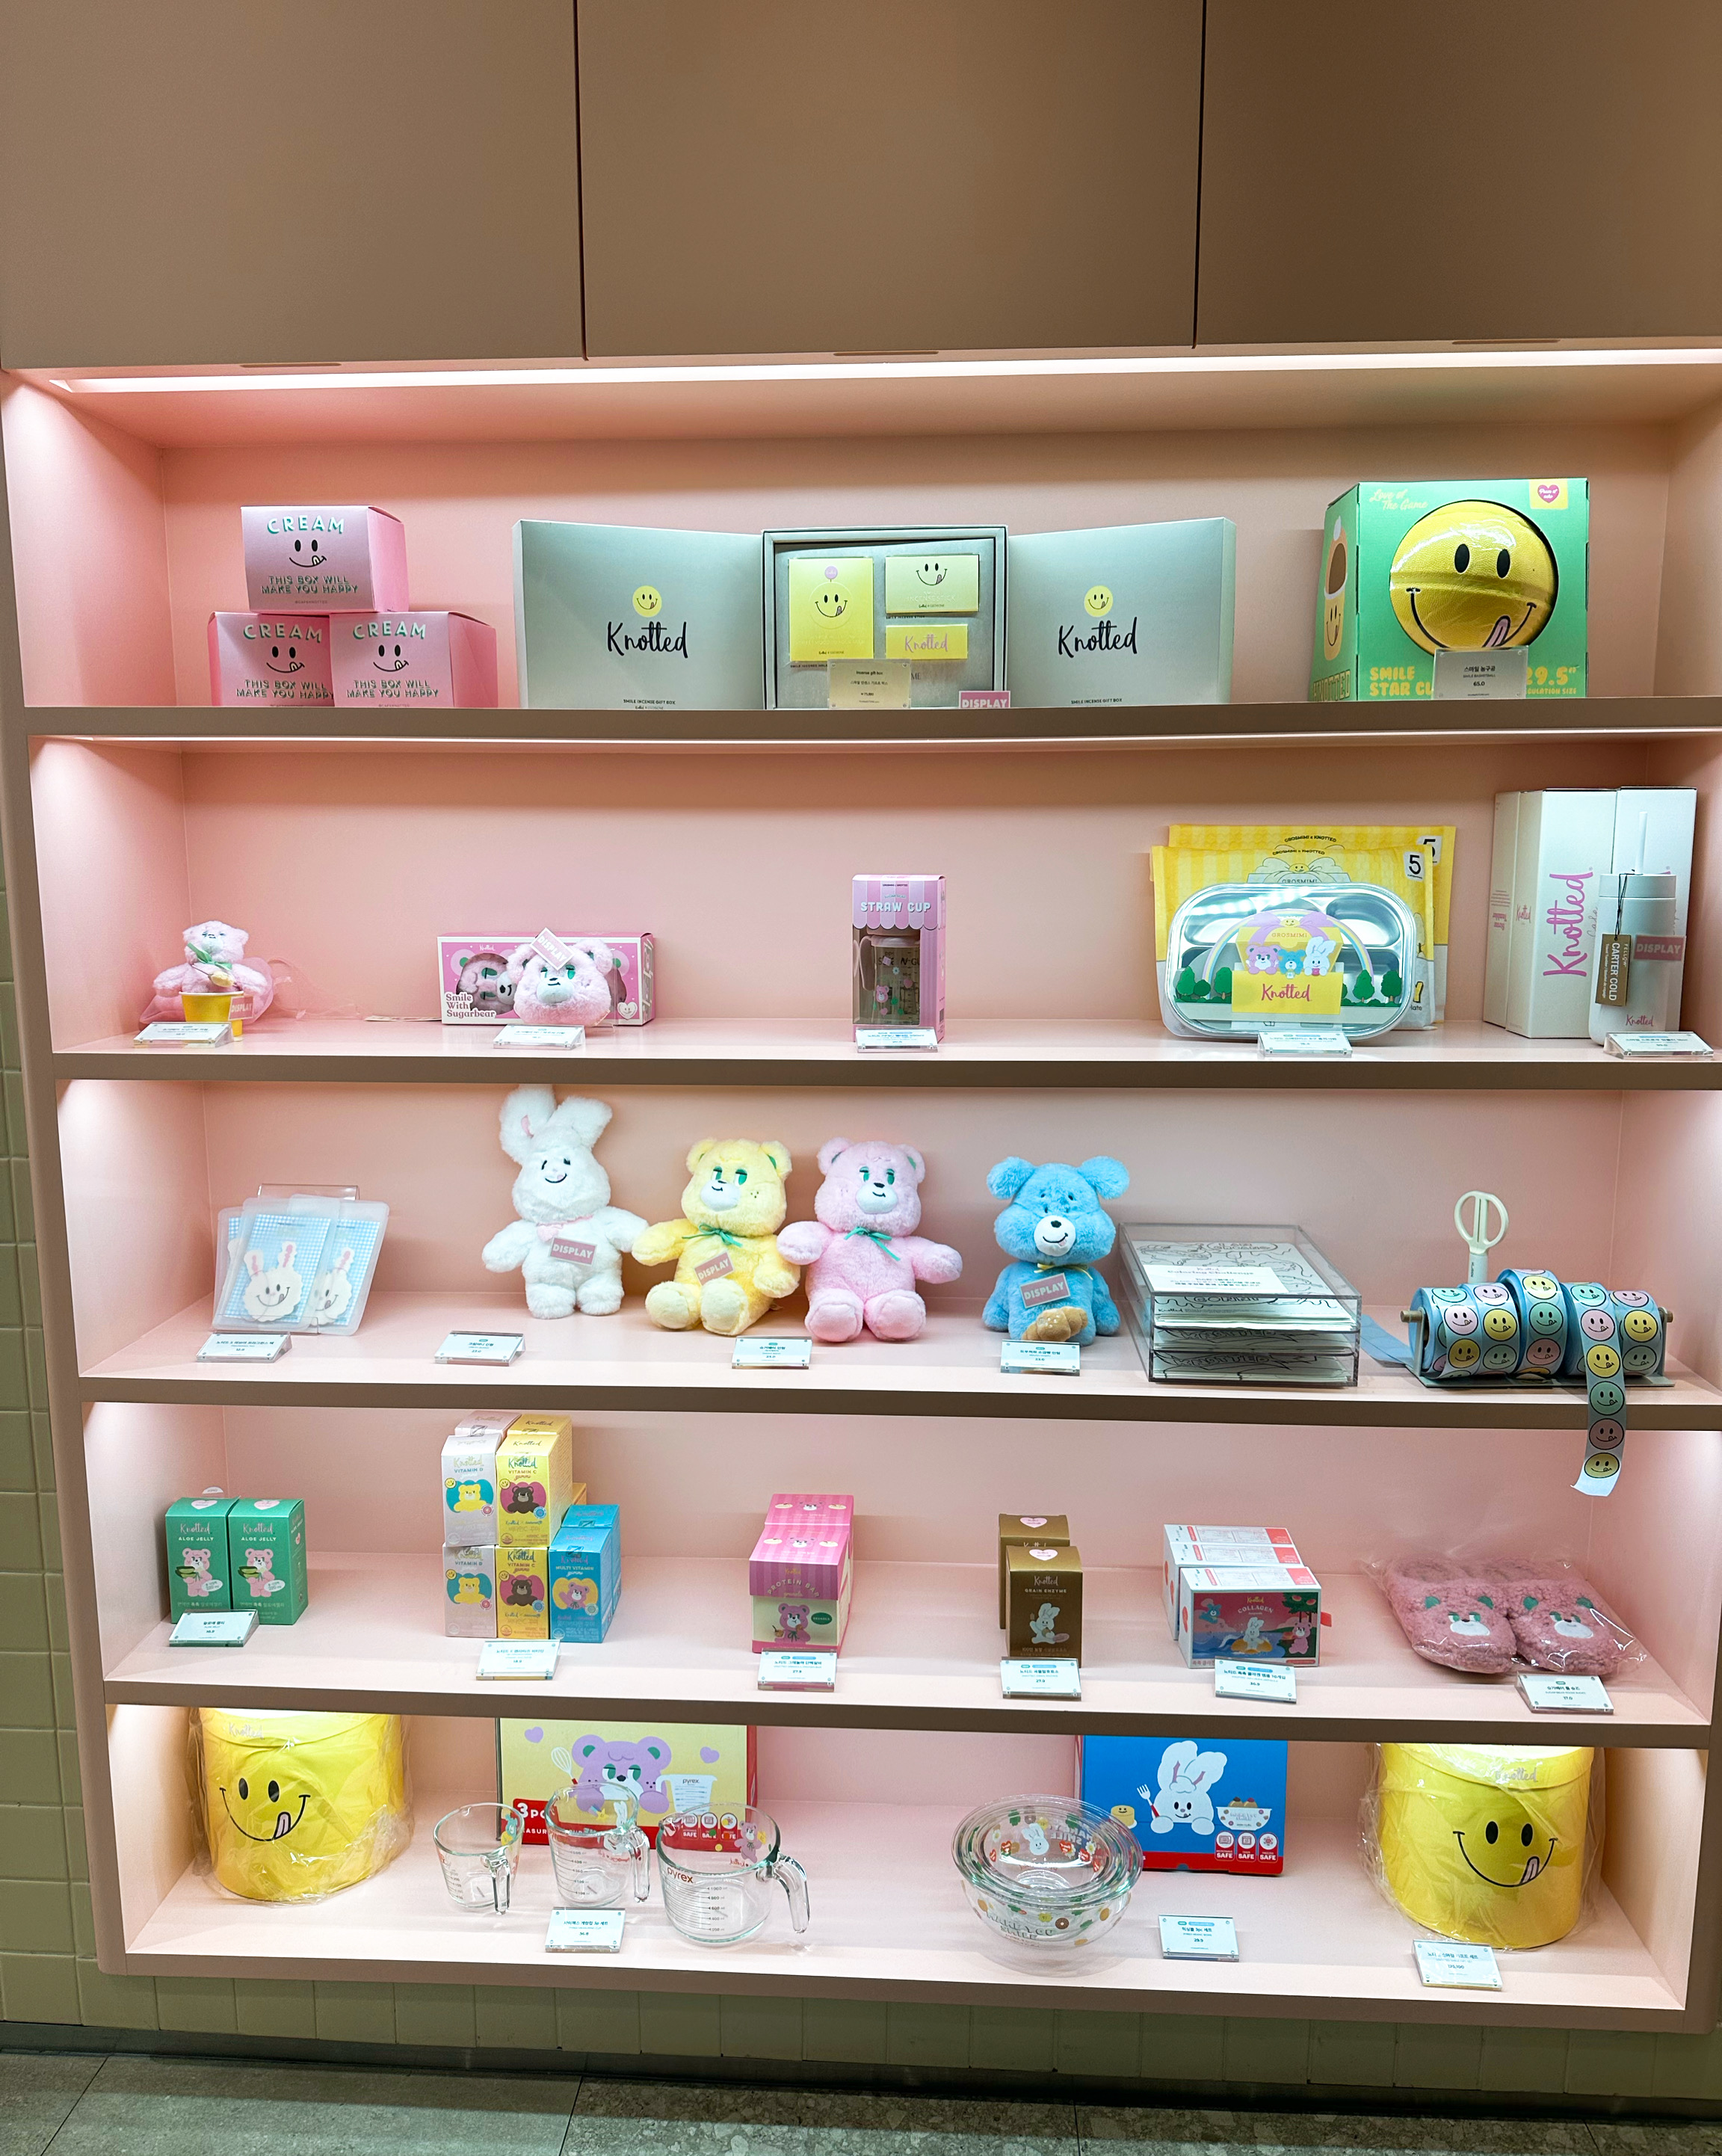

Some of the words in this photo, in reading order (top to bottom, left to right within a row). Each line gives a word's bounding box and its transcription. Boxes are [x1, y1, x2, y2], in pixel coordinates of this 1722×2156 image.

[1382, 500, 1398, 510] The
[1400, 501, 1428, 510] Game
[267, 515, 345, 535] CREAM
[269, 576, 293, 584] THIS
[297, 576, 318, 585] BOX
[262, 585, 291, 594] MAKE
[297, 585, 317, 594] YOU
[322, 585, 358, 594] HAPPY
[244, 623, 322, 643] CREAM
[353, 621, 426, 640] CREAM
[607, 621, 688, 659] Knotted
[904, 634, 948, 653] Knotted
[1058, 617, 1138, 658] Knotted
[1370, 666, 1415, 680] SMILE
[245, 680, 269, 689] THIS
[274, 680, 296, 689] BOX
[299, 681, 327, 691] WILL
[354, 680, 377, 689] THIS
[381, 680, 401, 689] BOX
[406, 680, 430, 689] WILL
[1370, 682, 1410, 696] STAR
[236, 689, 267, 698] MAKE
[272, 689, 294, 698] YOU
[299, 691, 334, 699] HAPPY
[346, 689, 375, 698] MAKE
[380, 689, 400, 697] YOU
[404, 689, 439, 697] HAPPY
[962, 699, 1007, 708] DISPLAY
[1409, 854, 1421, 875] 5
[860, 902, 902, 912] STRAW
[907, 902, 931, 913] CUP
[1543, 872, 1593, 977] Knotted
[537, 935, 567, 963] DISPLAY
[1636, 943, 1681, 954] DISPLAY
[1611, 943, 1620, 975] CARTER
[1262, 983, 1311, 1002] Knotted
[1609, 978, 1617, 1001] COLD
[445, 993, 472, 1002] Smile
[231, 1002, 253, 1013] DISPLAY
[446, 1009, 496, 1018] Sugarbear
[1626, 1014, 1653, 1026] Knotted
[552, 1242, 593, 1258] DISPLAY
[698, 1259, 729, 1281] DISPLAY
[1024, 1282, 1065, 1301] DISPLAY
[508, 1456, 537, 1468] Knotted
[180, 1523, 210, 1535] Knotted
[243, 1523, 274, 1535] Knotted
[507, 1548, 536, 1562] Knotted
[1034, 1576, 1058, 1586] Knotted
[768, 1579, 801, 1595] PROTEIN
[805, 1583, 820, 1598] BAR
[1247, 1596, 1265, 1604] Knotted
[1238, 1605, 1274, 1613] COLLAGEN
[667, 1867, 694, 1883] pyrex
